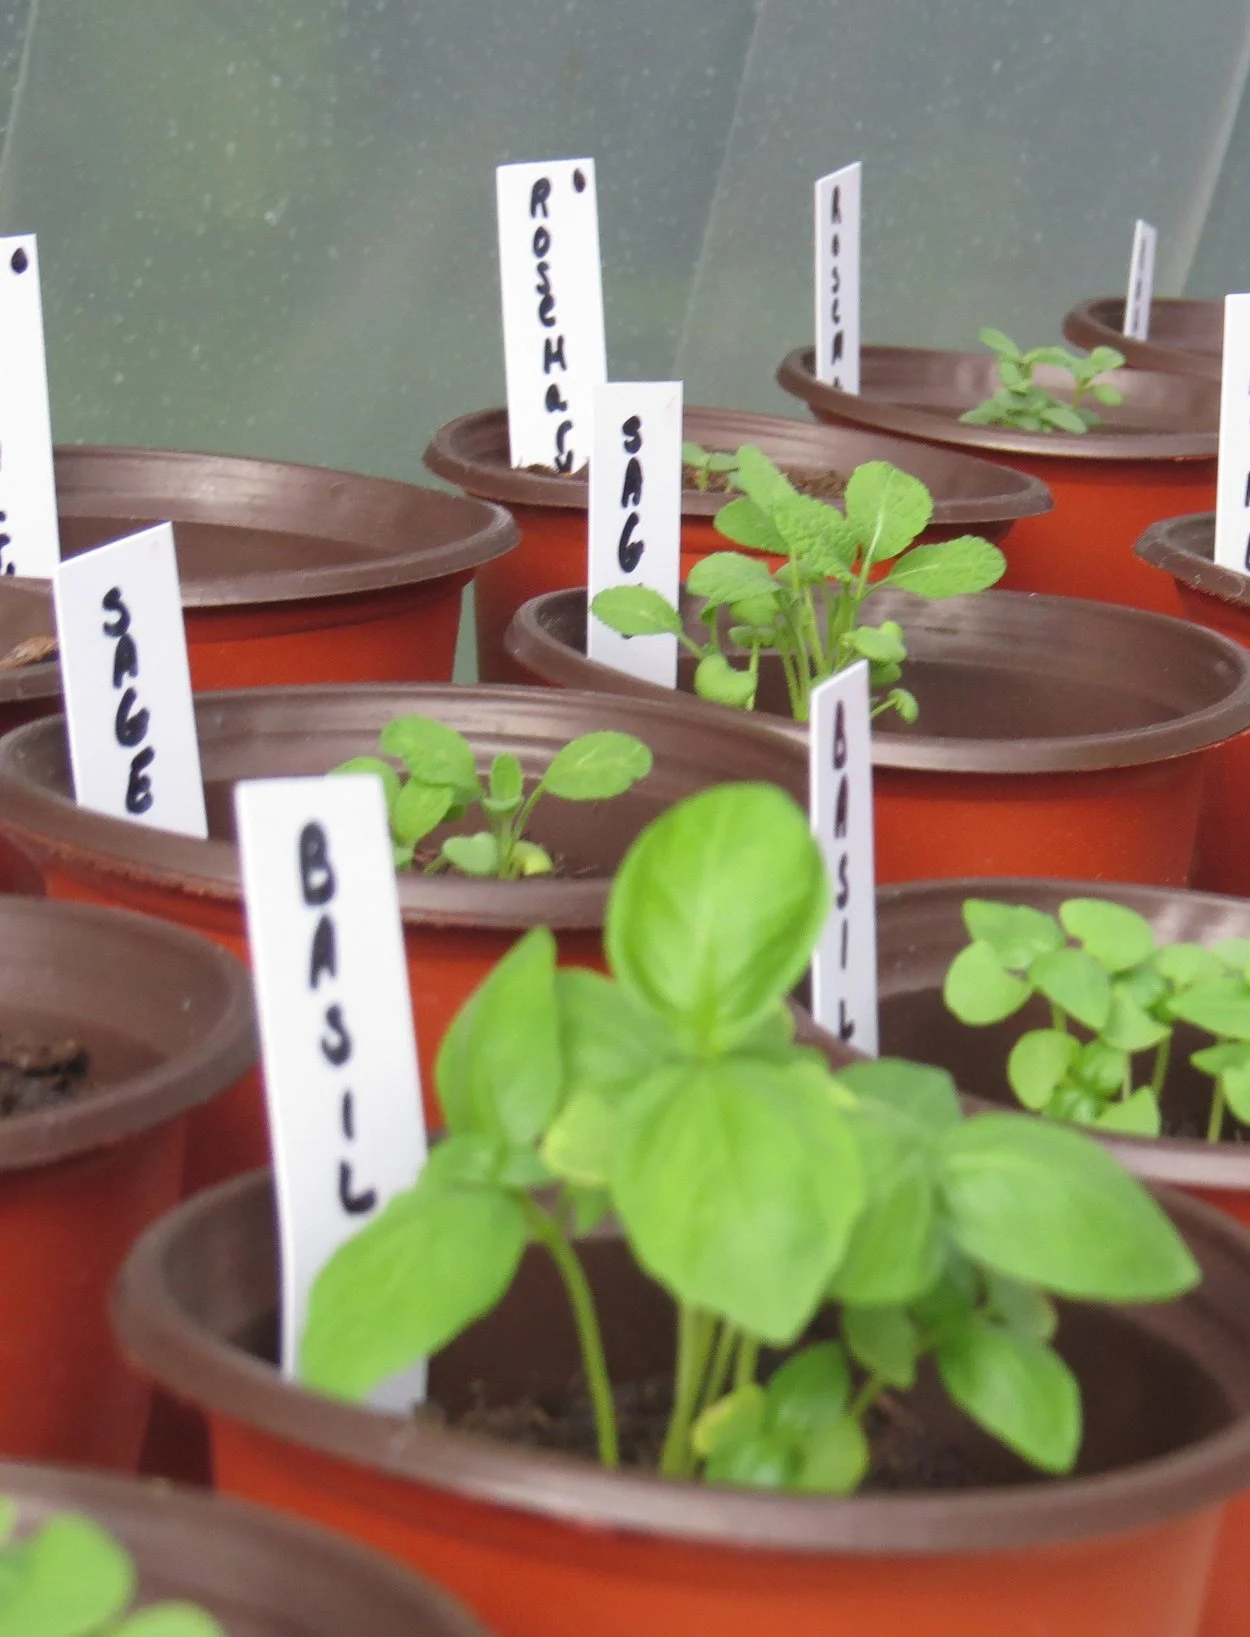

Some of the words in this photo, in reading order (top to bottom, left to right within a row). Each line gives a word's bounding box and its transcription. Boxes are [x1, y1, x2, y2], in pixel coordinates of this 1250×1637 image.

[618, 415, 645, 639] SAG
[102, 586, 154, 814] SAGE
[832, 699, 855, 1043] BASIL
[299, 820, 378, 1217] BASIL
